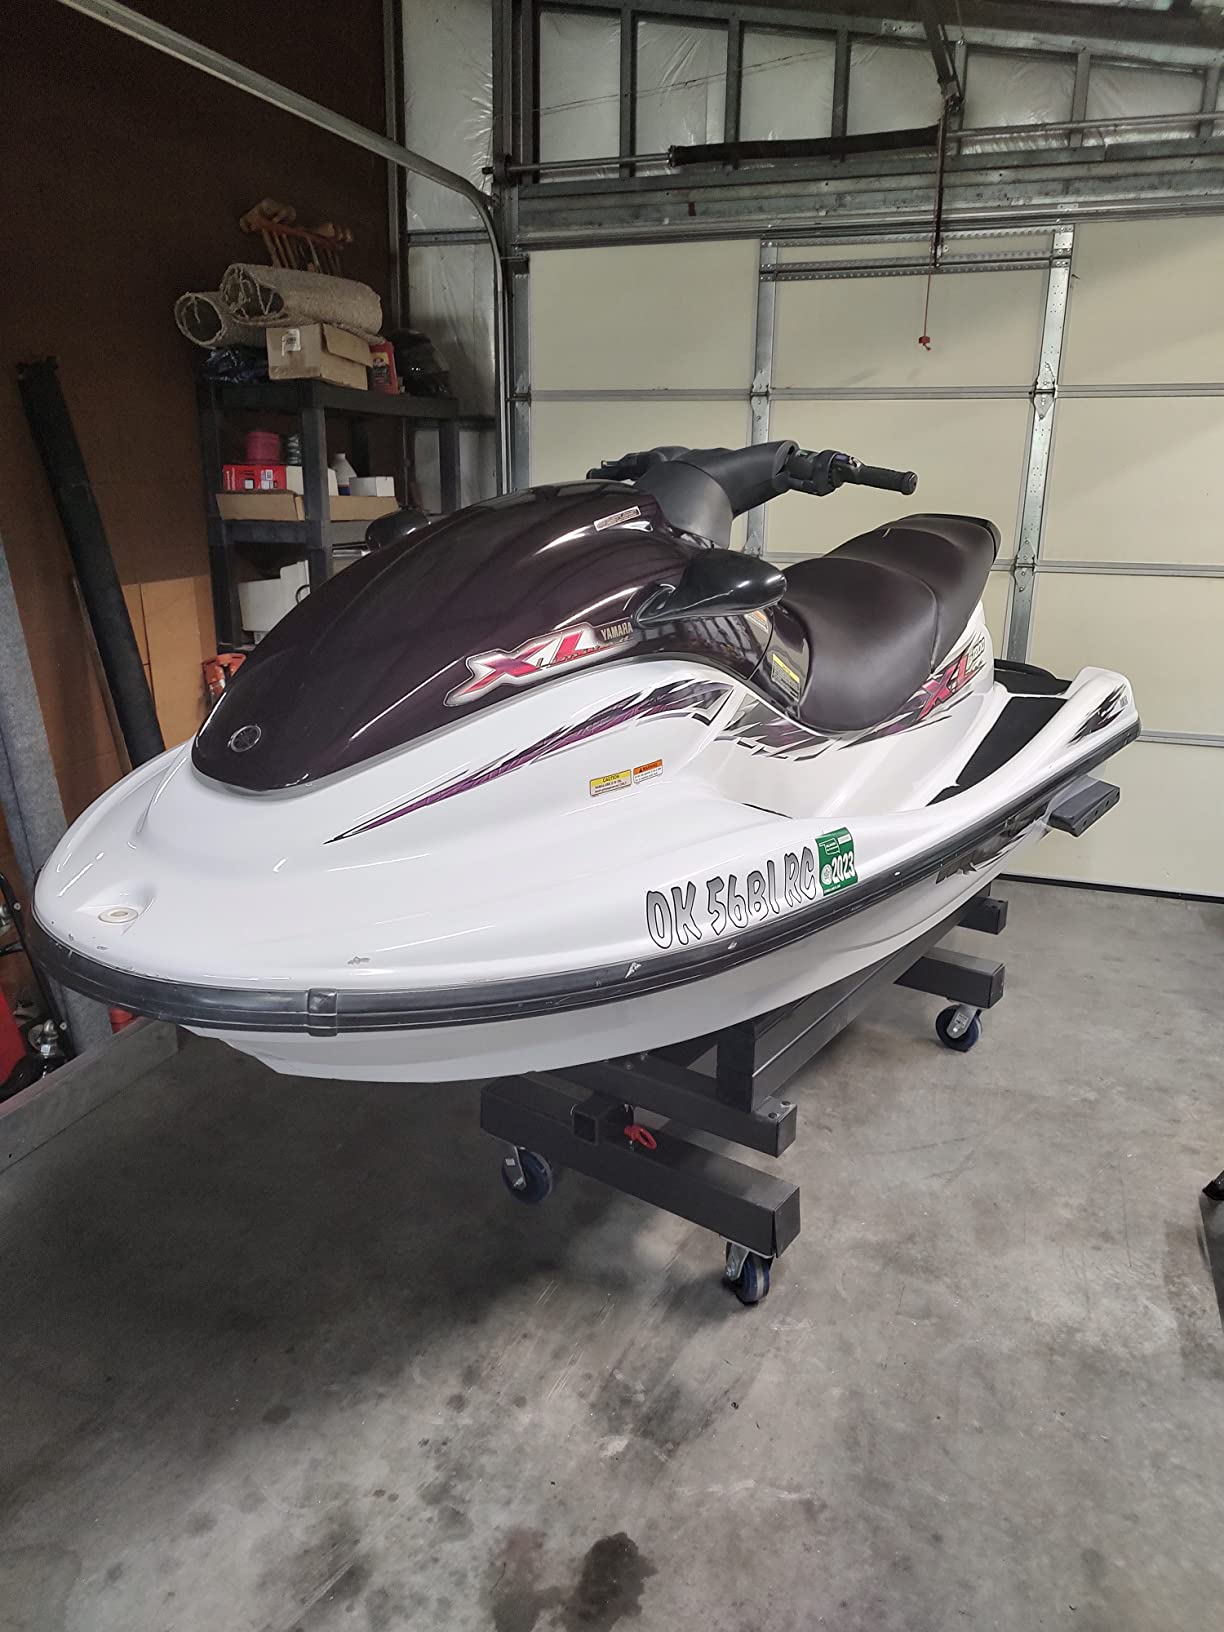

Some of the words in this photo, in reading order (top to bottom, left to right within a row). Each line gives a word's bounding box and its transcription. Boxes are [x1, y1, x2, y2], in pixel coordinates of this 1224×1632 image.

[600, 622, 633, 641] YAMAHA
[832, 851, 855, 884] 2023
[646, 881, 703, 949] OK
[784, 847, 816, 907] RC
